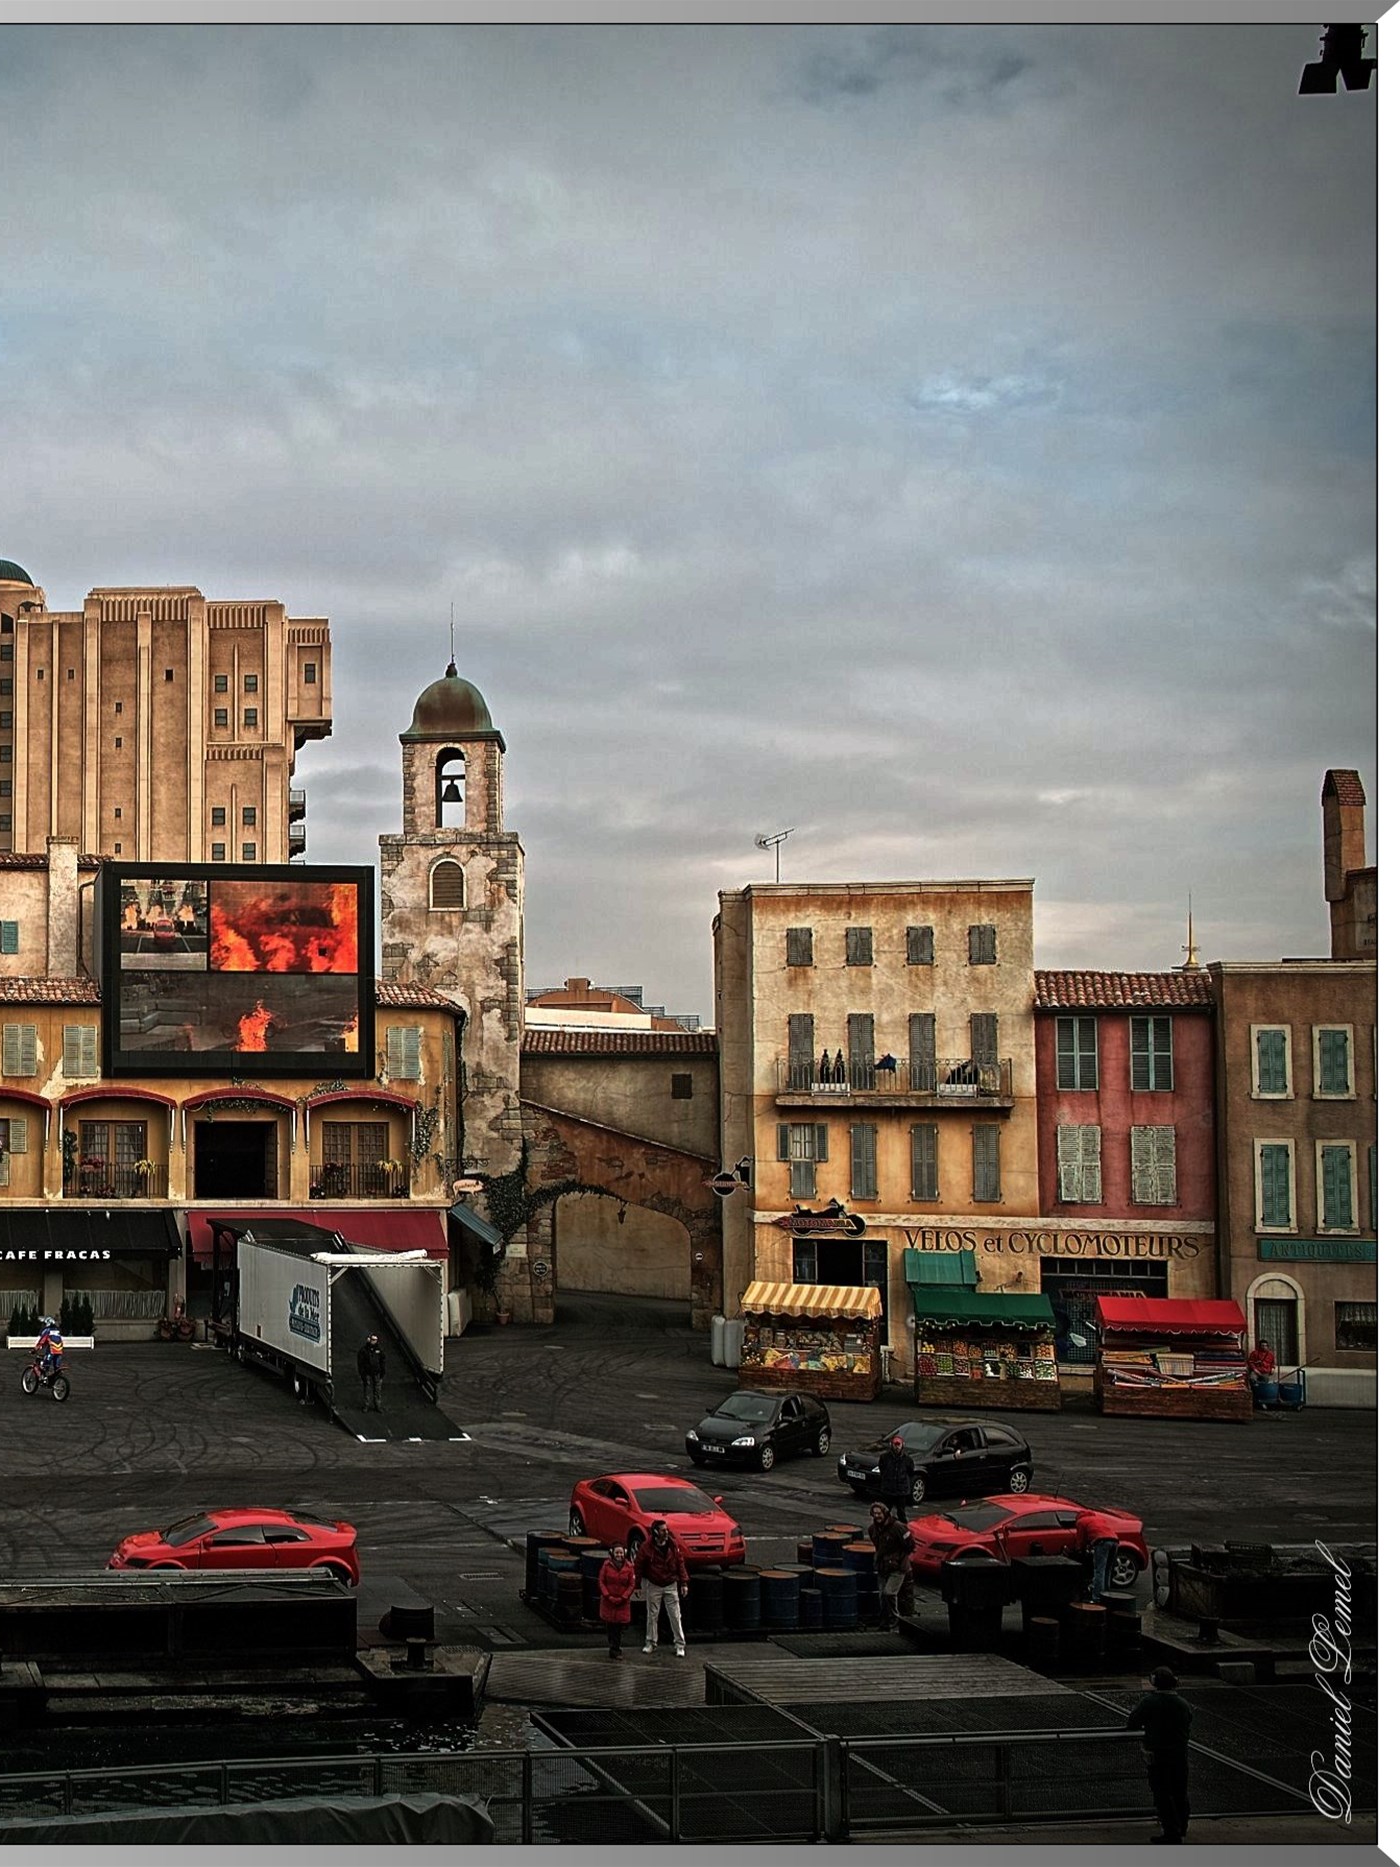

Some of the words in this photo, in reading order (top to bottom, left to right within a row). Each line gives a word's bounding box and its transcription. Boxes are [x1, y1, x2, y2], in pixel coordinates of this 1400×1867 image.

[789, 1218, 855, 1228] MOTOMANIA
[903, 1227, 977, 1252] VELOS
[983, 1235, 1004, 1253] et
[1008, 1232, 1200, 1260] CYCLOMOTEURS
[44, 1250, 111, 1260] FRACAS
